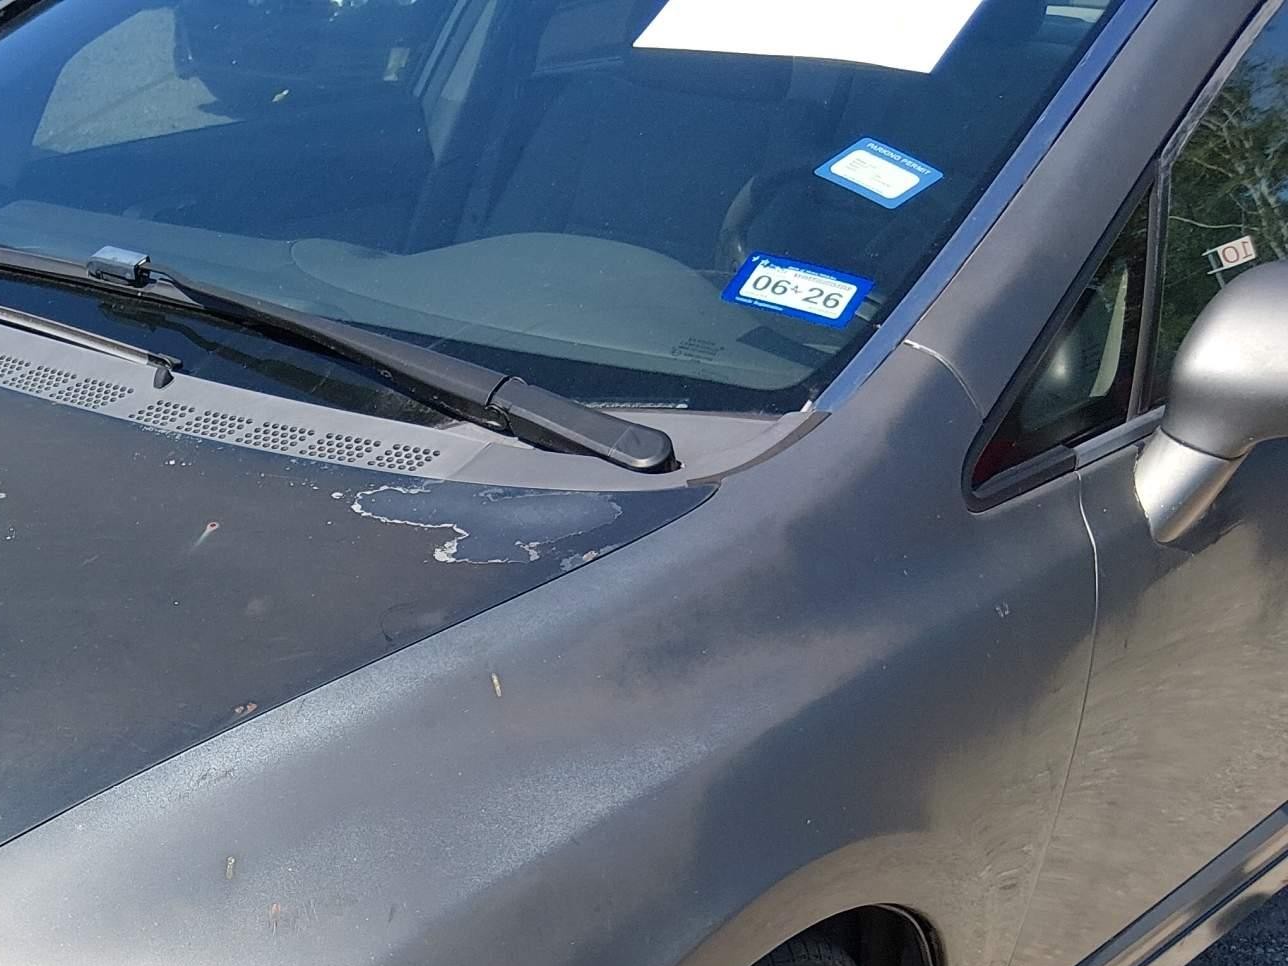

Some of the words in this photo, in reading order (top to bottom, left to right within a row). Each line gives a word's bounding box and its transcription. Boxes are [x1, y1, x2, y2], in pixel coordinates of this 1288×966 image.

[866, 142, 902, 161] PARKING
[900, 158, 931, 175] PERMIT
[752, 274, 791, 296] 06
[801, 287, 844, 309] 26
